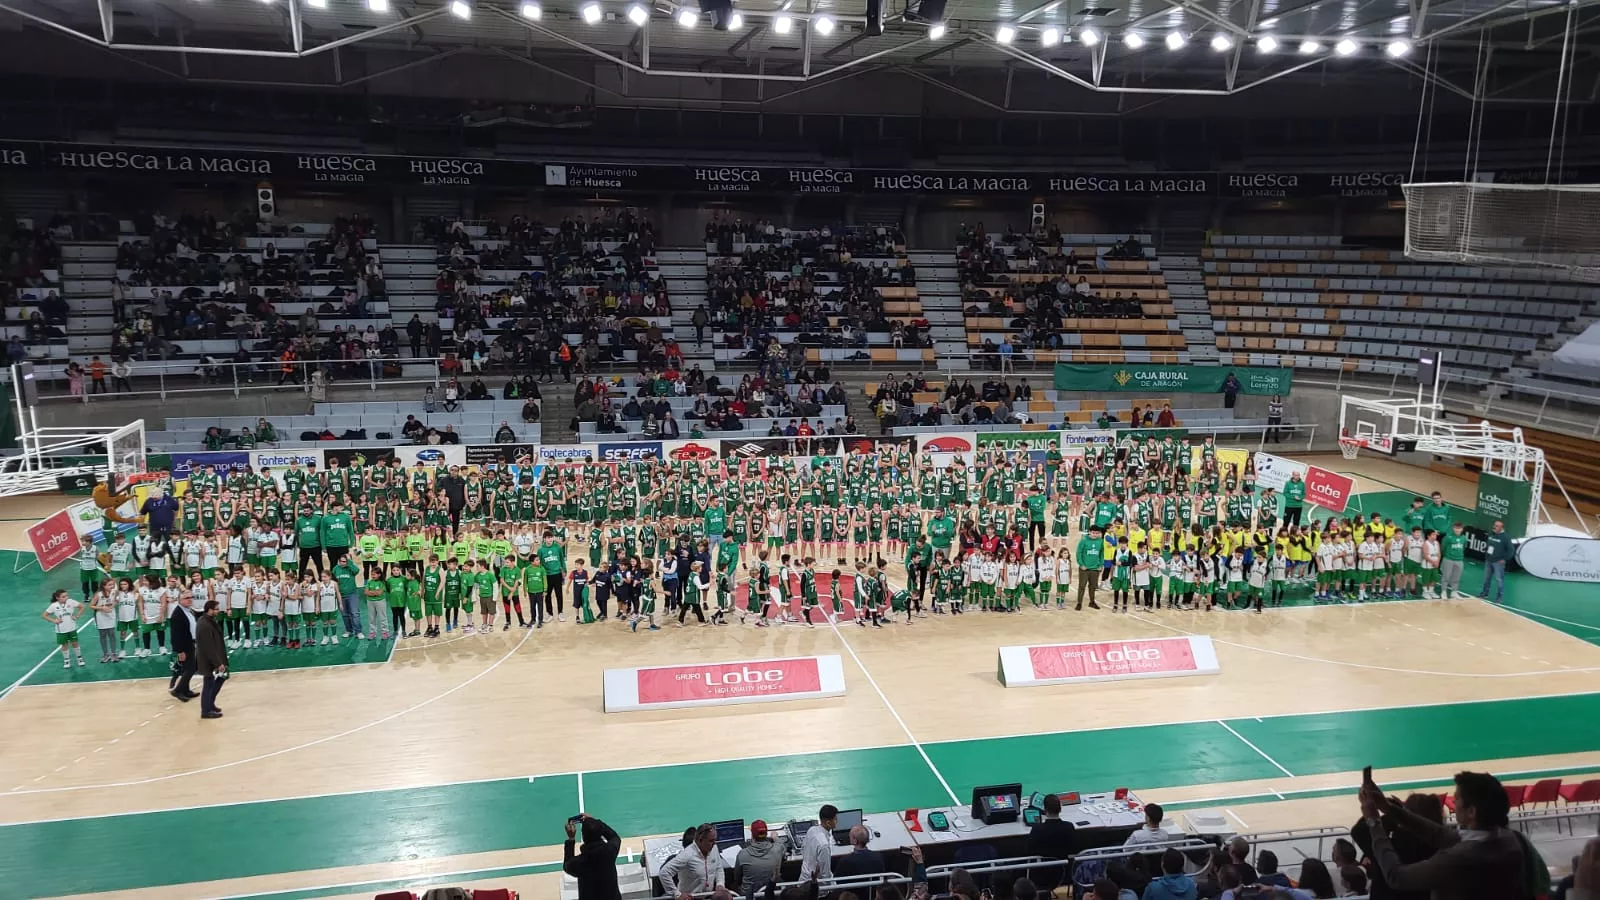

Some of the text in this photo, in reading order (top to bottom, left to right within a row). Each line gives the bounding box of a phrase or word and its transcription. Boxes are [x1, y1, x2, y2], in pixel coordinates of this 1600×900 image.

[585, 178, 622, 188] Huesca
[1134, 371, 1189, 380] CAJA RURAL
[1310, 481, 1341, 498] Lobe
[1480, 491, 1510, 507] Lobe
[41, 531, 68, 553] Lobe
[1090, 645, 1161, 664] Lobe
[675, 666, 784, 686] GRUPO Lobe
